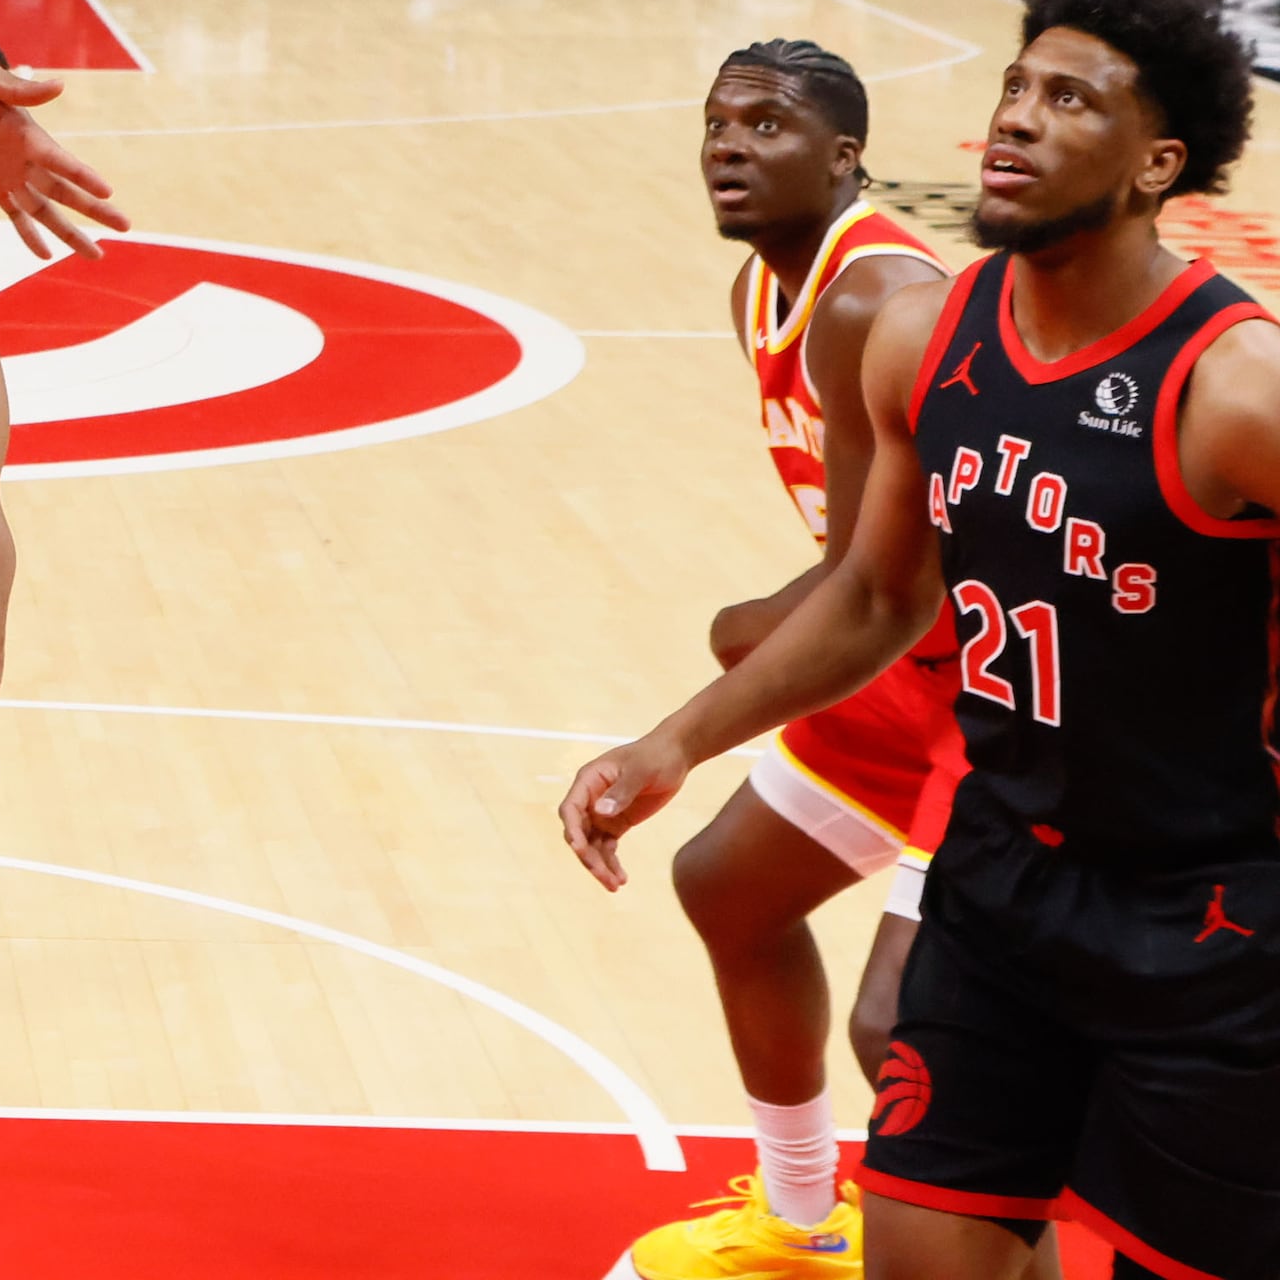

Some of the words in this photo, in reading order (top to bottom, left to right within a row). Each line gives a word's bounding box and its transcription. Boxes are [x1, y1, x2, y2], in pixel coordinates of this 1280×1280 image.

[1078, 410, 1108, 432] Sun
[1111, 417, 1143, 438] Life
[952, 579, 1061, 728] 21
